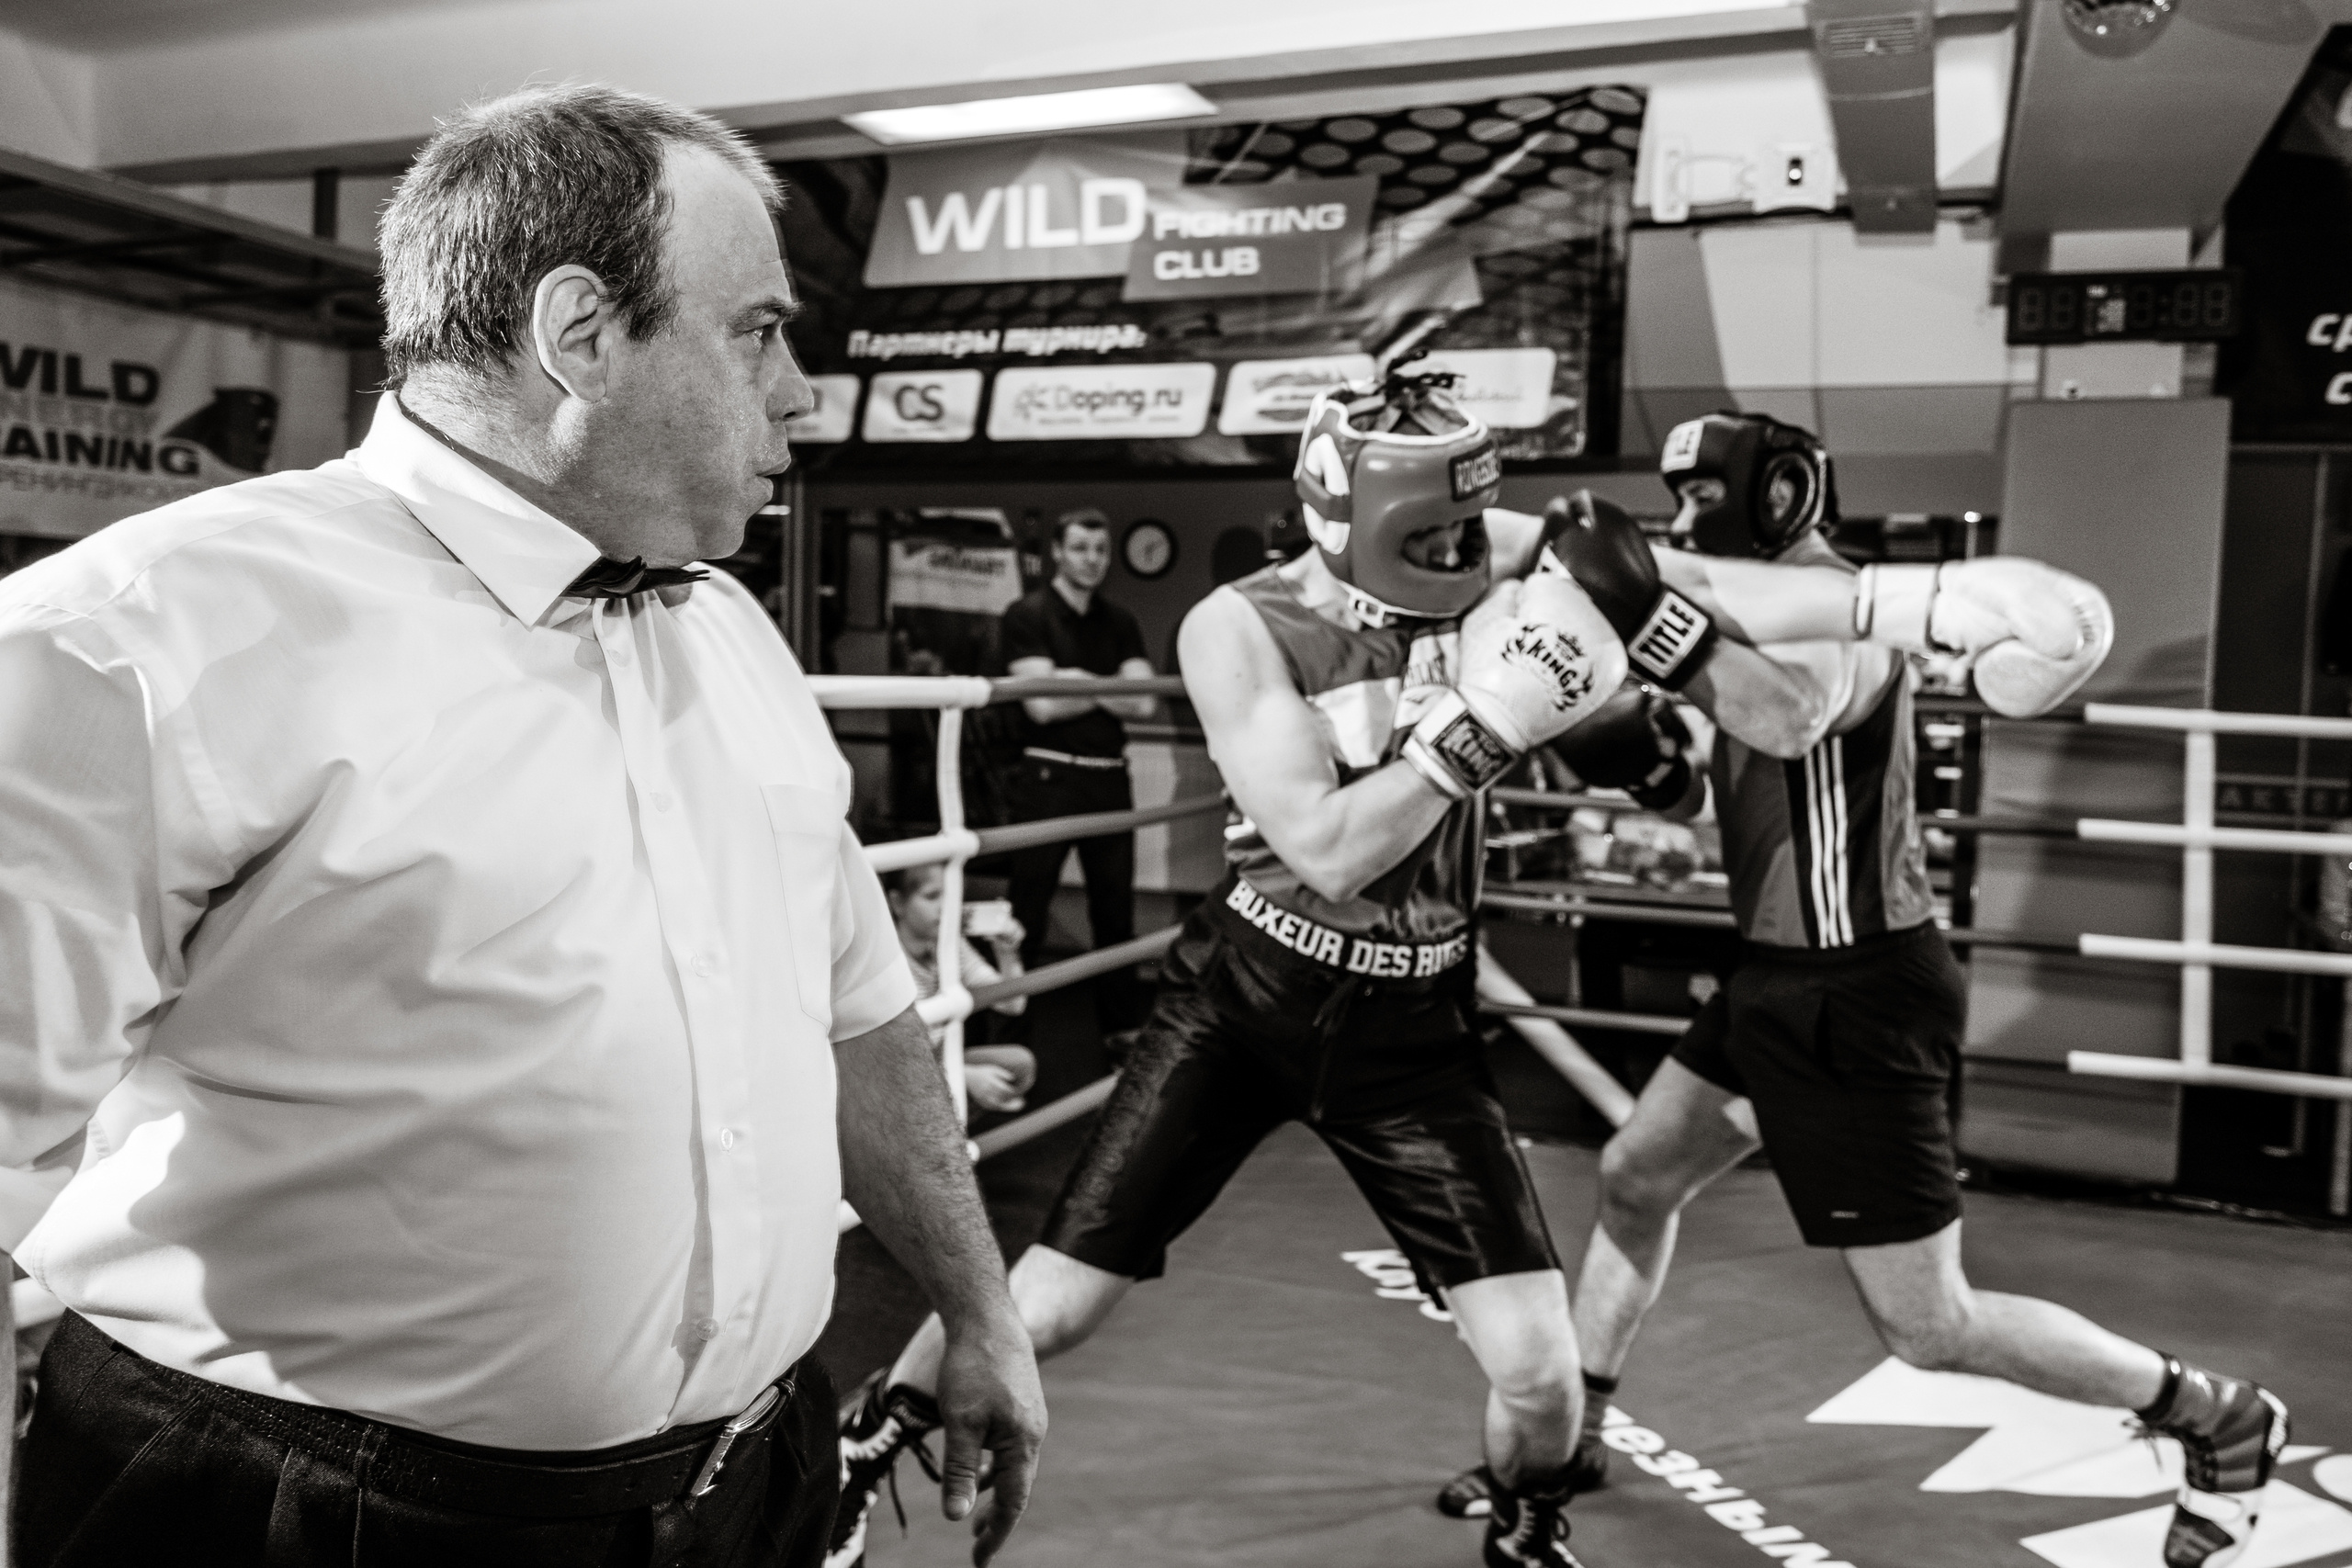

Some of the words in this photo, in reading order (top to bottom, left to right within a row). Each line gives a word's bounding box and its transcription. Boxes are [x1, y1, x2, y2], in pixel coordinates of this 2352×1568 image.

[905, 178, 1147, 255] WILD
[1154, 202, 1347, 241] FIGHTING
[1154, 245, 1260, 280] CLUB
[894, 384, 944, 422] CS
[1638, 604, 1695, 664] TITLE
[1526, 638, 1577, 688] KING
[1346, 938, 1412, 978] DES
